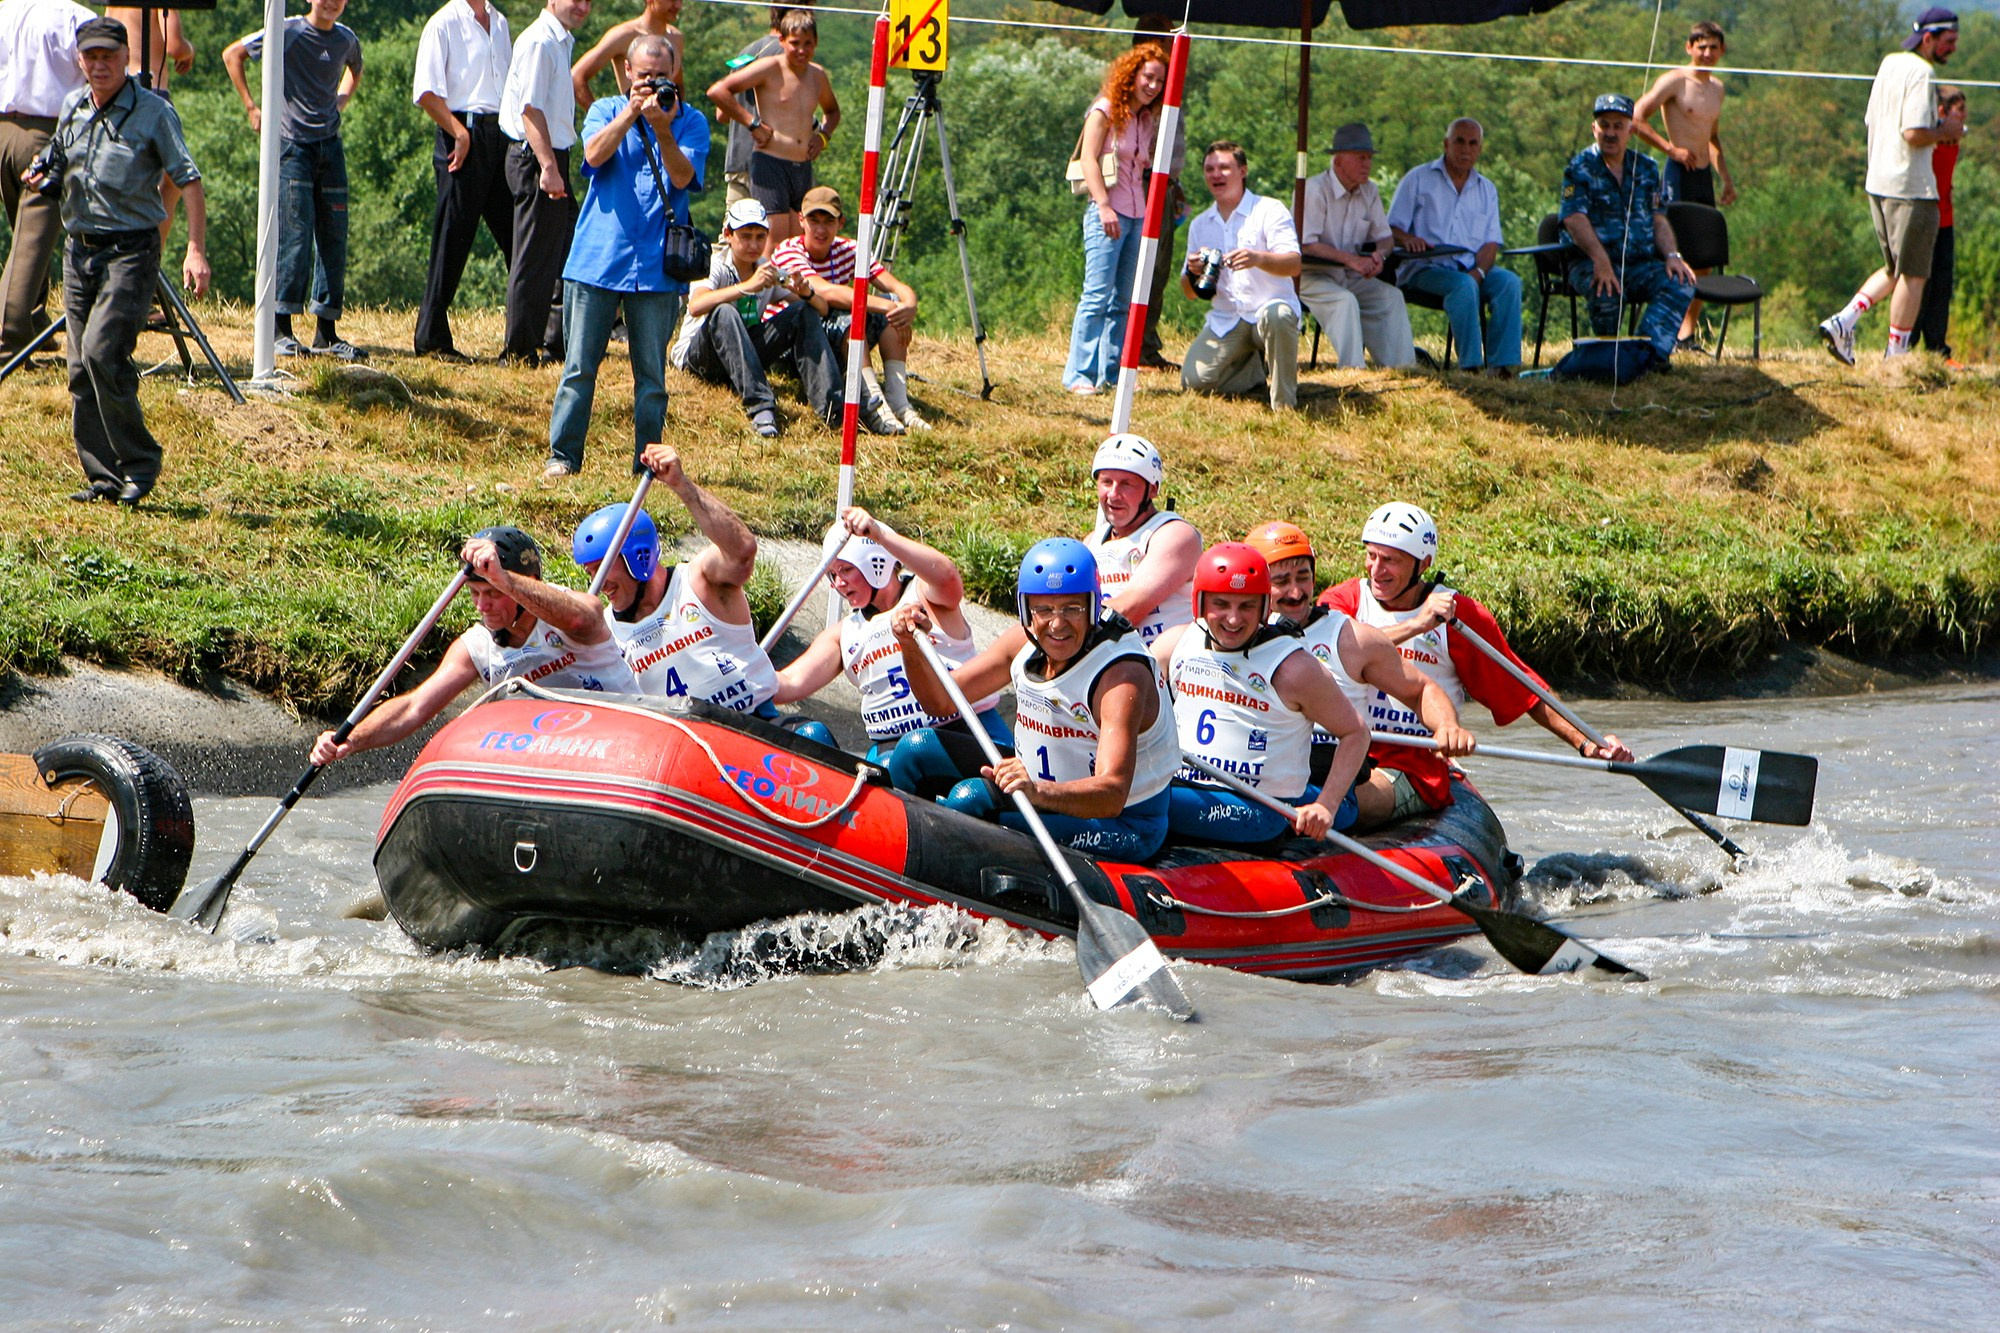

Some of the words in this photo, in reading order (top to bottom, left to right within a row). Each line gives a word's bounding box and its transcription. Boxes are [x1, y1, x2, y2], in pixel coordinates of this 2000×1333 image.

[895, 14, 942, 64] 13
[665, 666, 689, 698] 4
[886, 665, 911, 700] 5
[1196, 709, 1217, 745] 6
[480, 731, 614, 760] ГЕОЛИНК
[1036, 745, 1056, 783] 1
